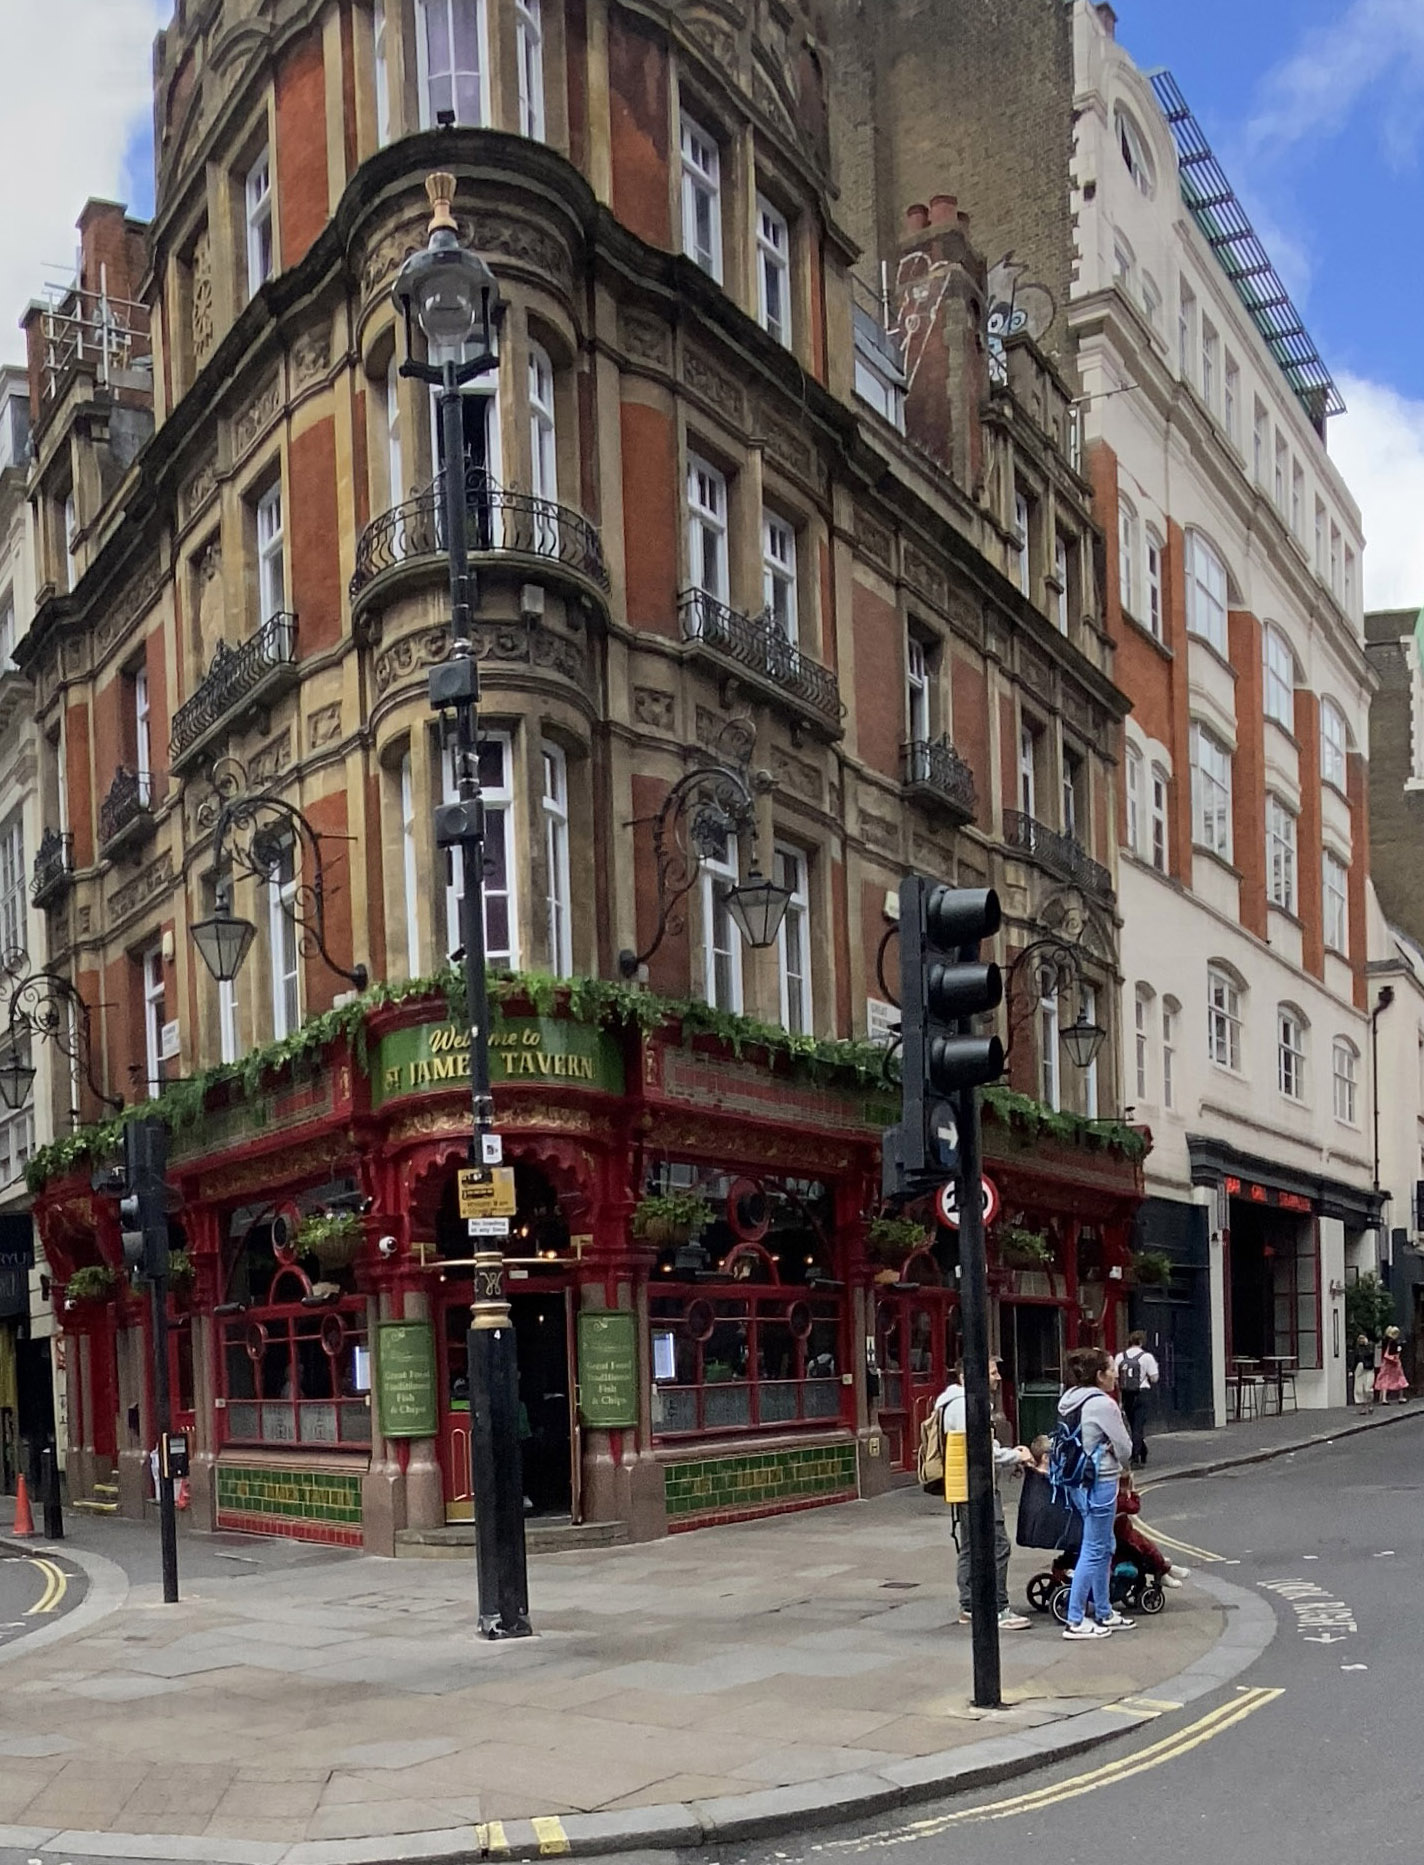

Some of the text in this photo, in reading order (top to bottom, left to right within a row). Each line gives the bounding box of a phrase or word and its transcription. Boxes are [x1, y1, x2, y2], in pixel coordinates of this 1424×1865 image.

[429, 1024, 540, 1053] Welme to
[409, 1054, 472, 1086] JAME
[502, 1051, 594, 1079] TAVERN
[493, 1329, 501, 1340] 4
[598, 1385, 617, 1393] Fish
[396, 1393, 415, 1402] Fish
[600, 1396, 627, 1406] Chips
[399, 1405, 427, 1416] Chips
